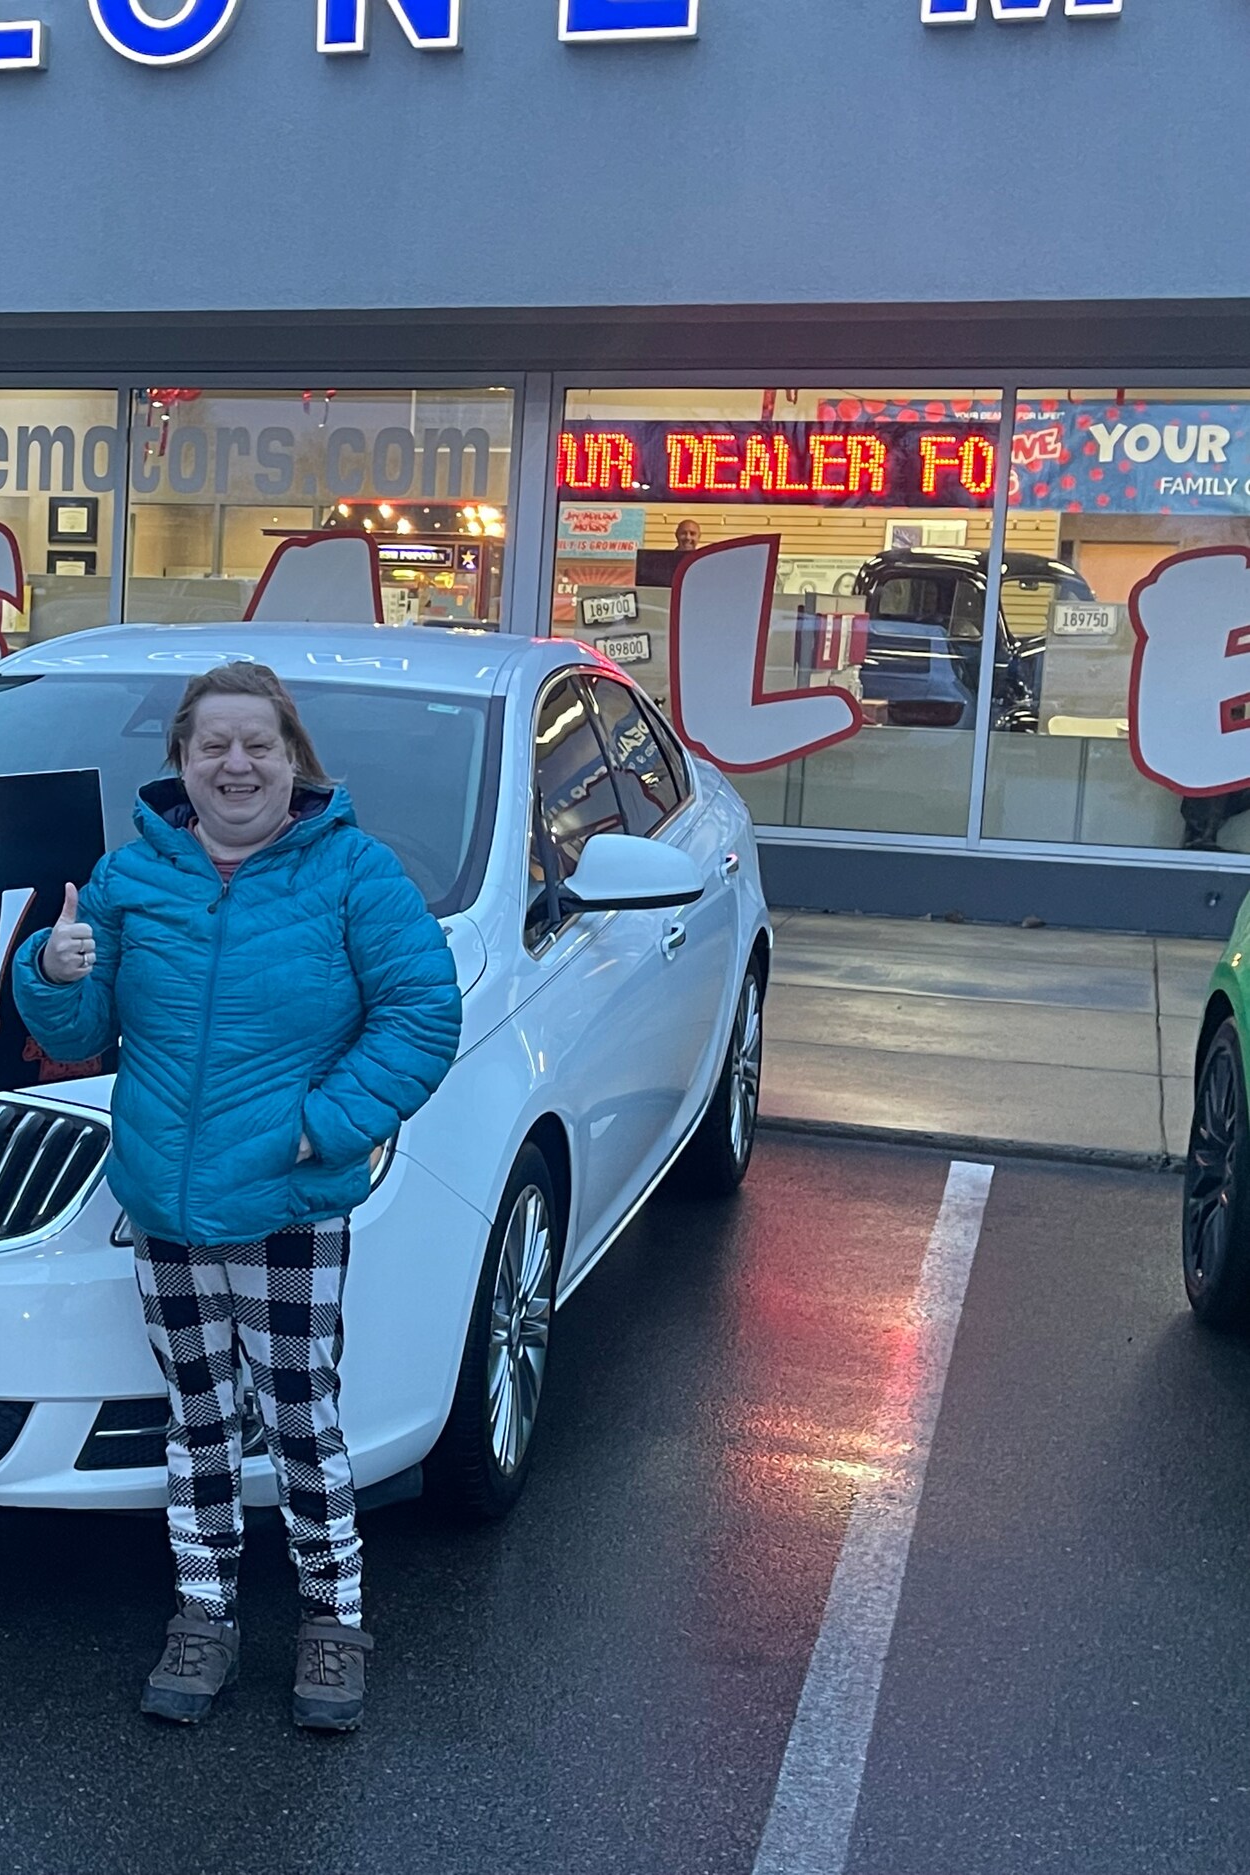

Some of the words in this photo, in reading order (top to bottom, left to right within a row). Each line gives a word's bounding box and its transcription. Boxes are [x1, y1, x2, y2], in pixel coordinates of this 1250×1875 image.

[1089, 422, 1231, 464] YOUR
[666, 433, 886, 492] DEALER
[919, 435, 995, 493] FO
[1160, 476, 1239, 496] FAMILY
[578, 540, 587, 550] IS
